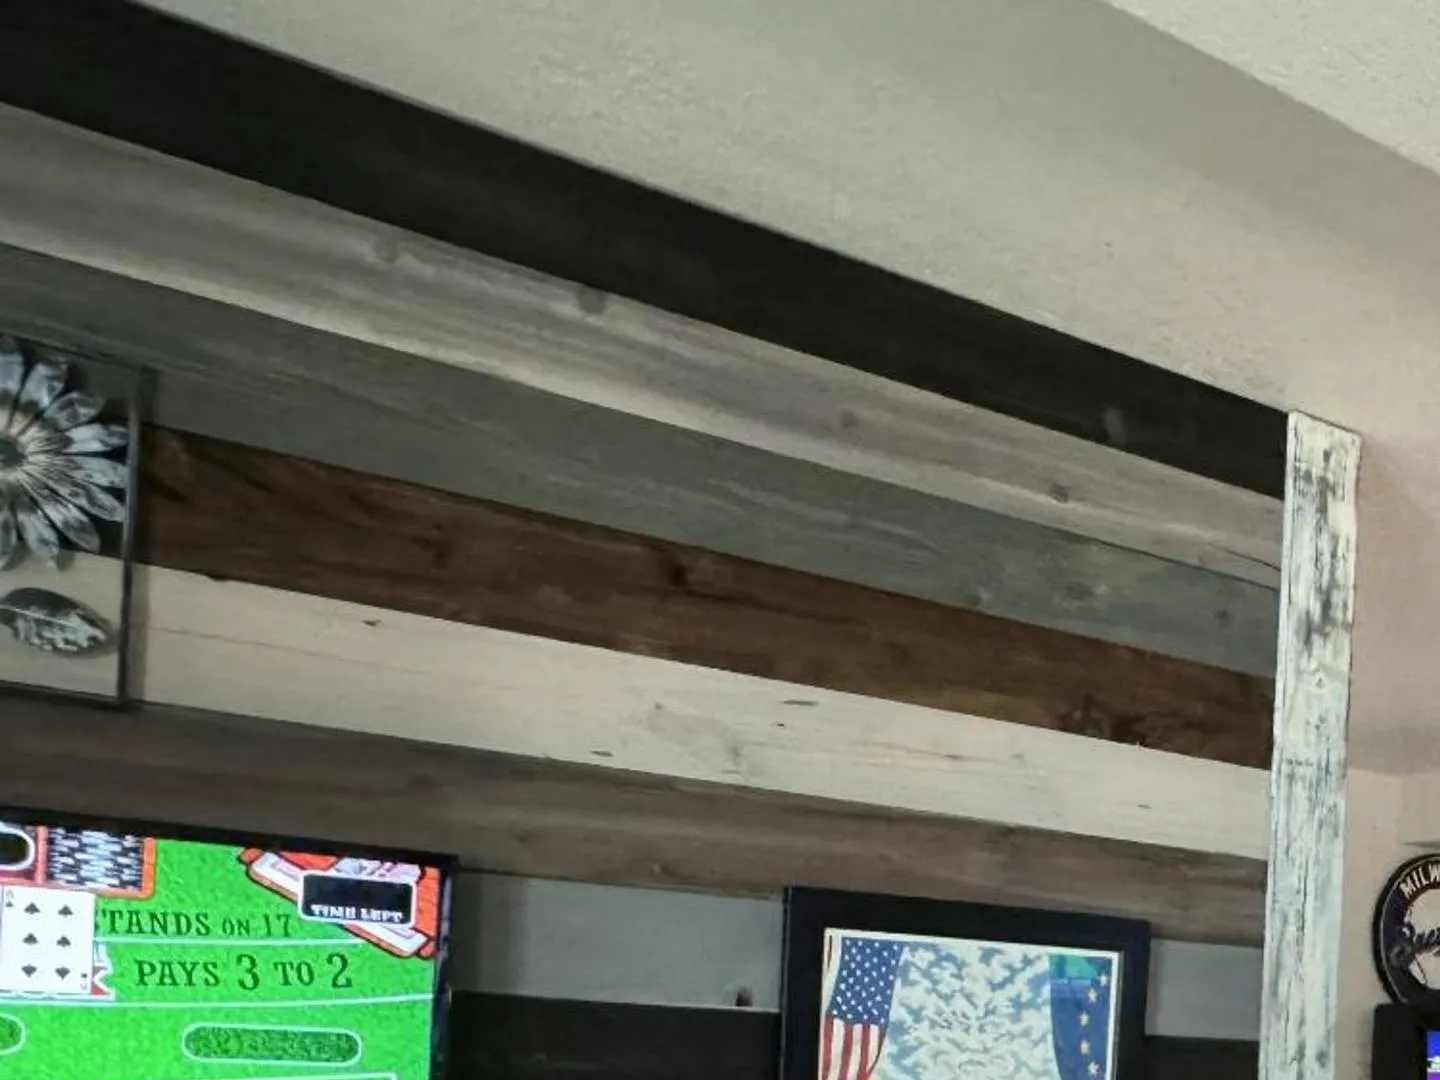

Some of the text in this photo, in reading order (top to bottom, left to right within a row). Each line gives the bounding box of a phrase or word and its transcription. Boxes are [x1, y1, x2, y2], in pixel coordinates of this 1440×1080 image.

[222, 917, 250, 937] ON
[263, 913, 292, 938] 17
[310, 903, 404, 923] TIME LEFT
[133, 952, 354, 991] PAYS 3 TO 2
